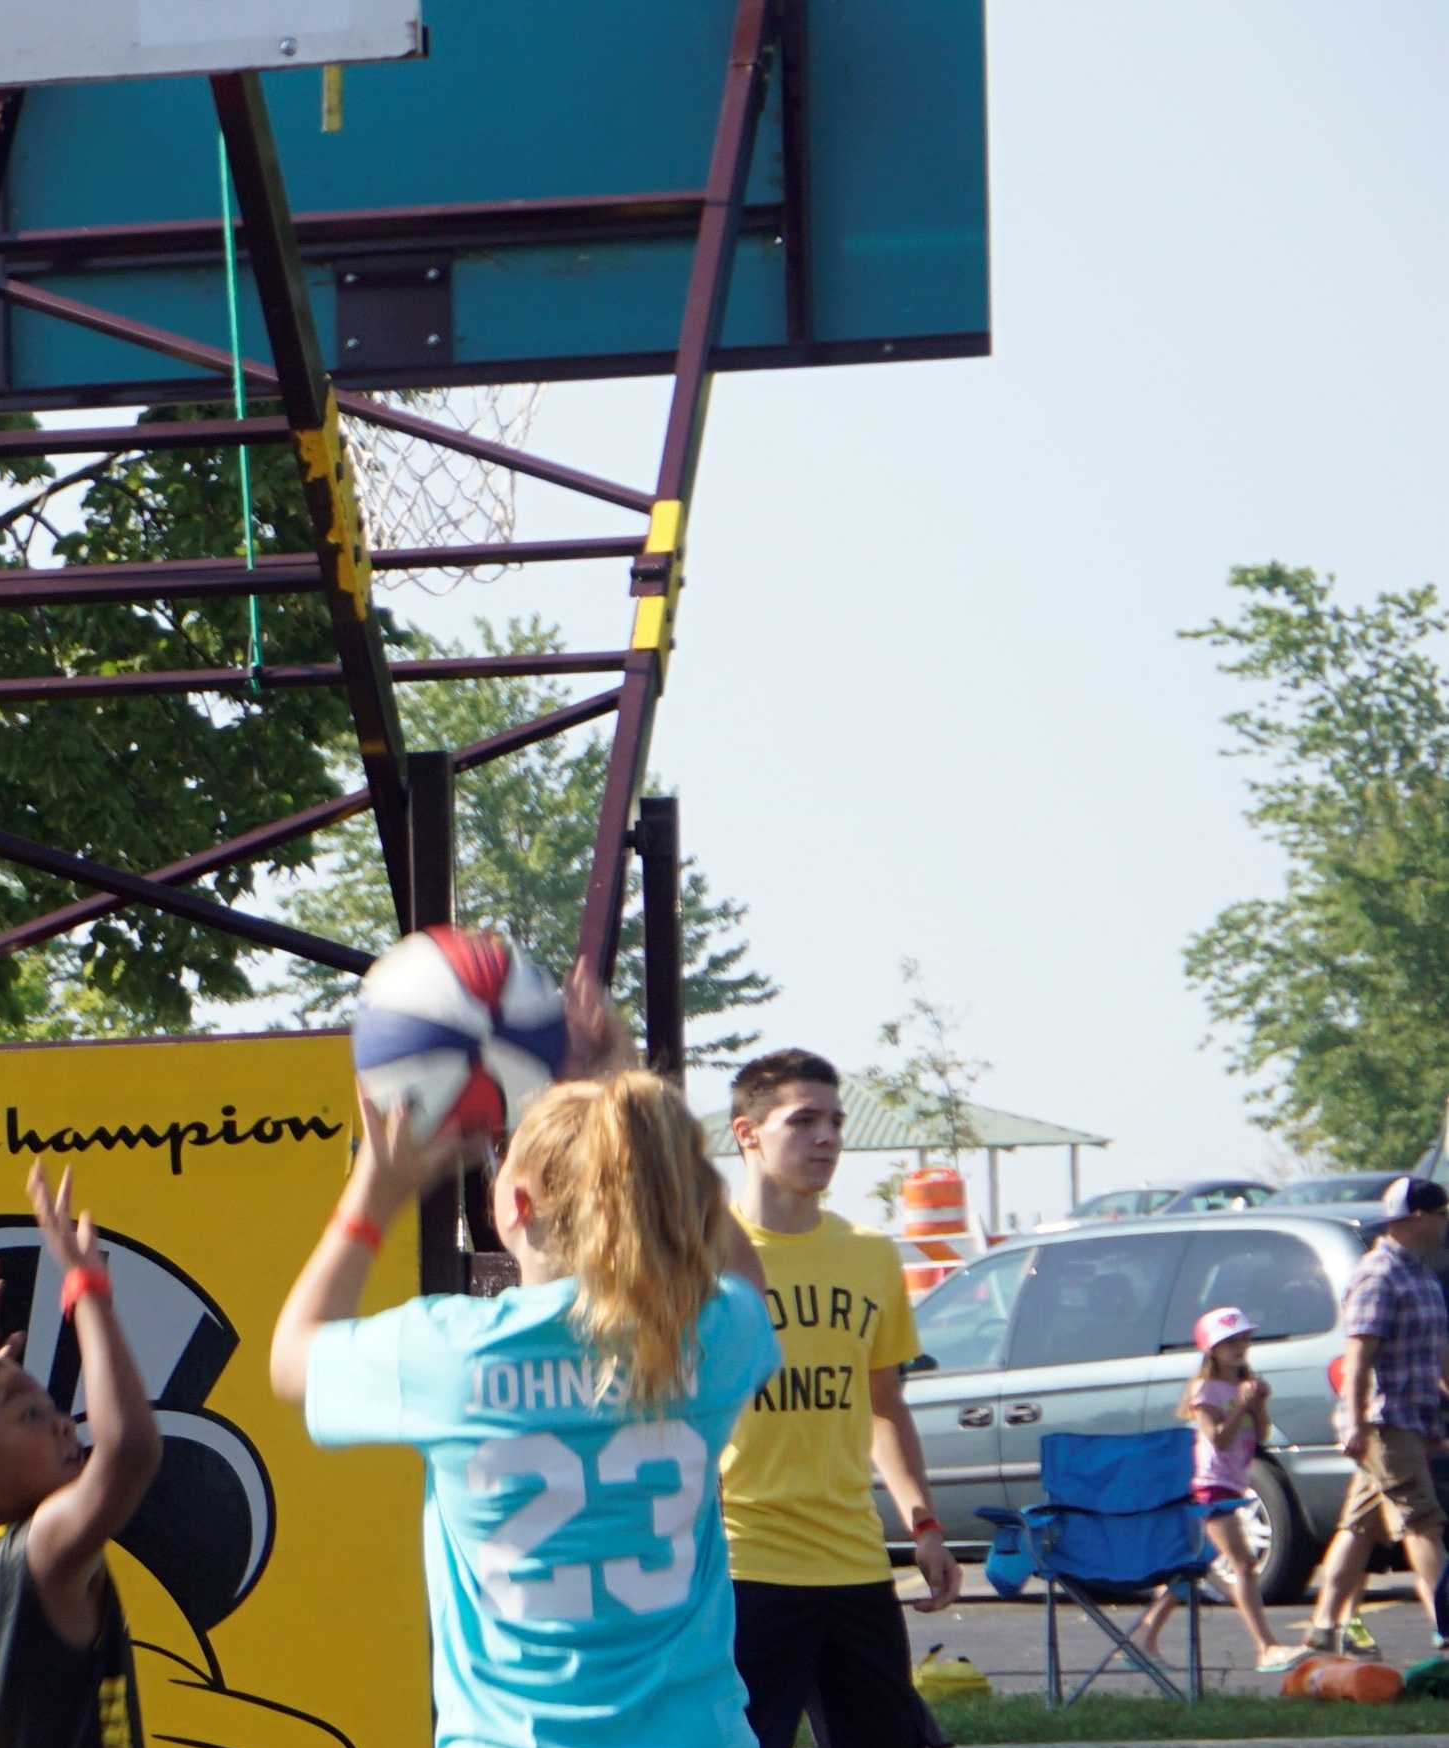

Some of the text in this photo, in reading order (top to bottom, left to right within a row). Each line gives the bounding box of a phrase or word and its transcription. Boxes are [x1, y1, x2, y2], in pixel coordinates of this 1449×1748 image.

[764, 1284, 879, 1340] OURT
[464, 1357, 700, 1414] JOHNSN
[467, 1417, 708, 1620] 23
